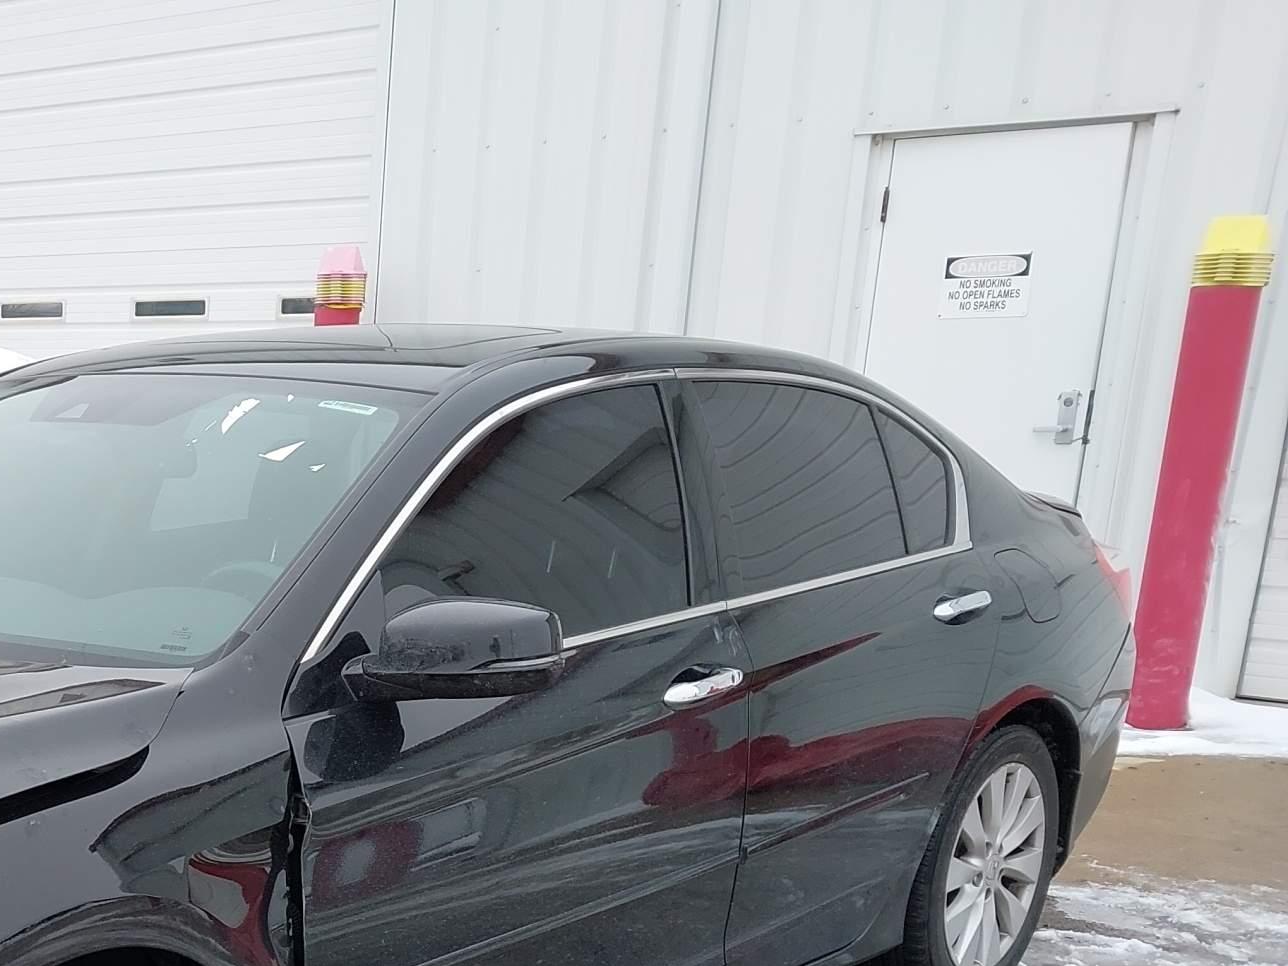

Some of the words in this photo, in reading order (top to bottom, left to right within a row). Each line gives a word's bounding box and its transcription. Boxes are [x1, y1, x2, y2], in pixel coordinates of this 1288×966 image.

[956, 260, 1018, 273] DANGER
[959, 279, 972, 289] NO
[973, 278, 1012, 289] SMOKING
[948, 290, 961, 300] NO
[962, 289, 985, 300] OPEN
[986, 288, 1021, 299] FLAMES
[959, 301, 972, 311] NO
[973, 300, 1007, 311] SPARKS
